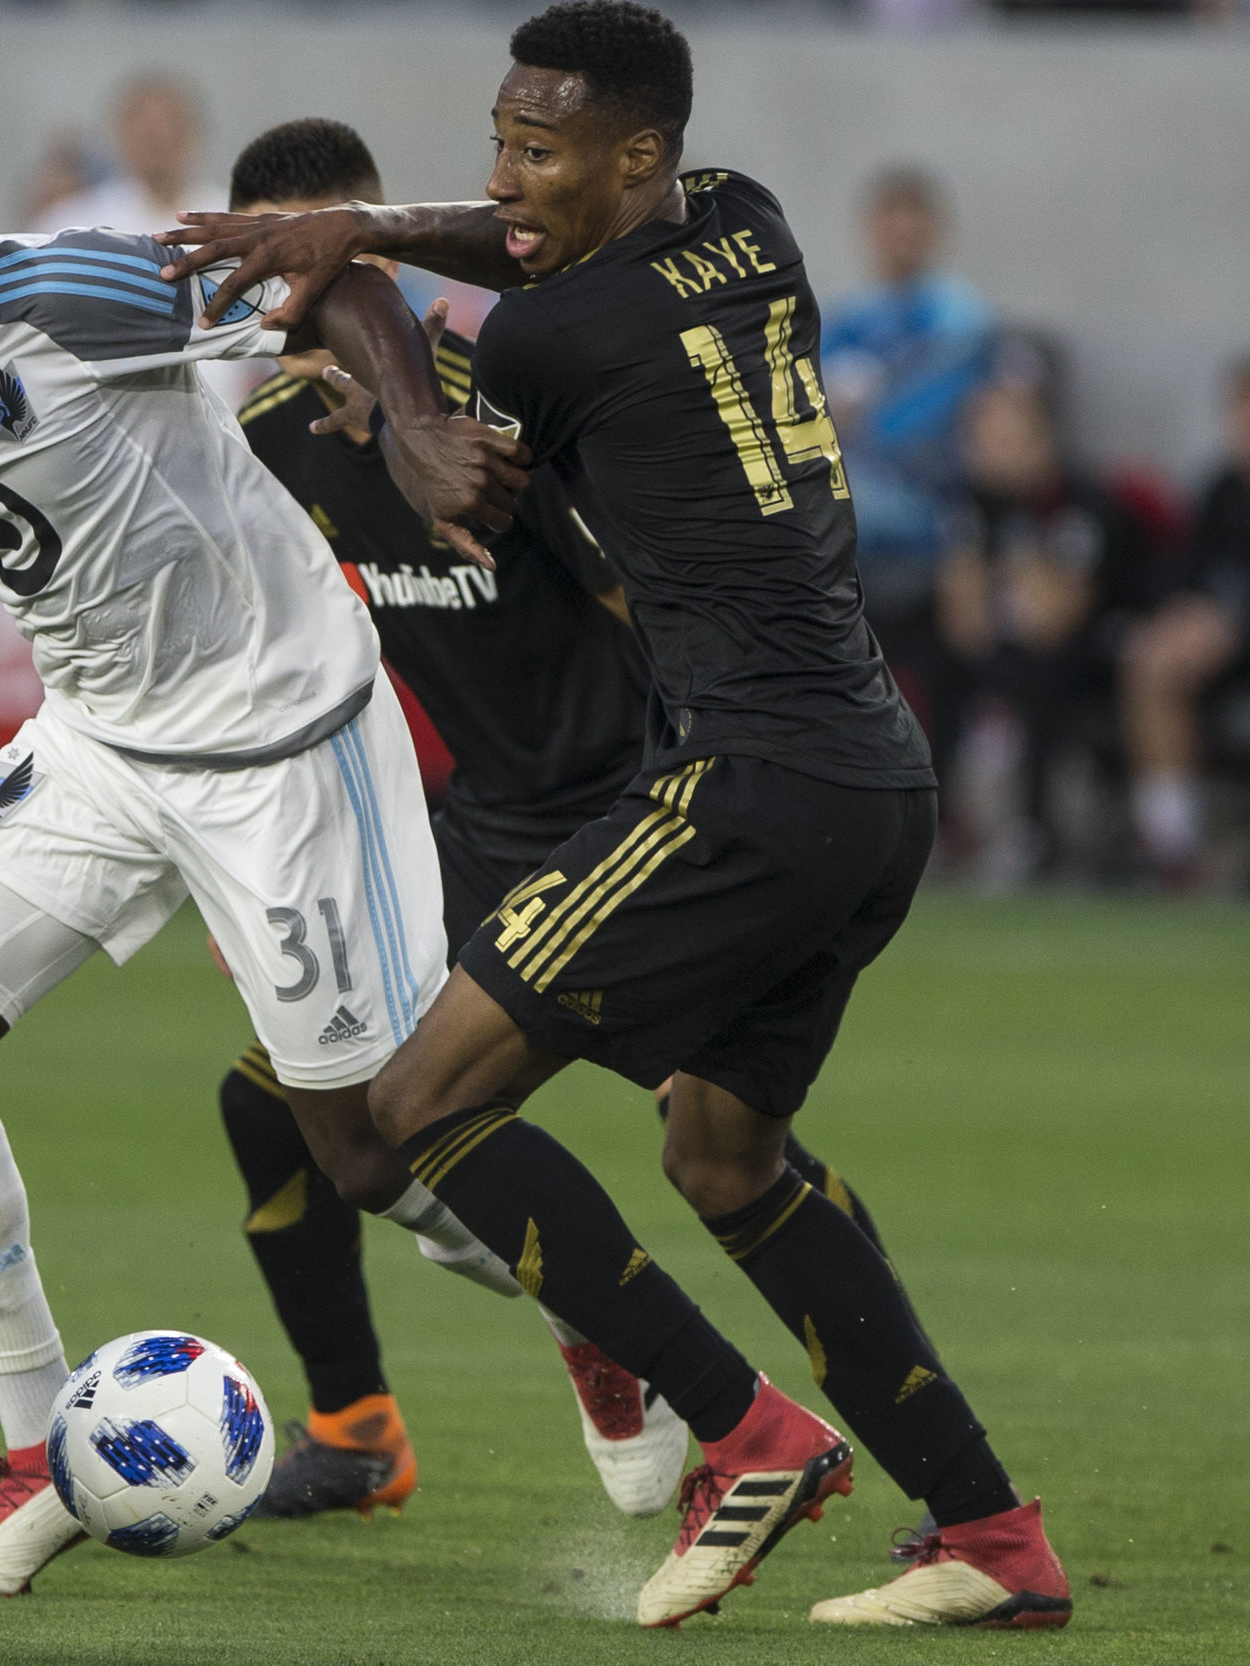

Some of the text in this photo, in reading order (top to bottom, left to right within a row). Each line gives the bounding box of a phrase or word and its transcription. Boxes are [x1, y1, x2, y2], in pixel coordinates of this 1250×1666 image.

[650, 229, 777, 299] KAYE
[679, 296, 851, 517] 14
[265, 897, 353, 1003] 31
[318, 1021, 368, 1045] adidas
[557, 994, 601, 1025] adidas
[65, 1370, 102, 1410] adidas
